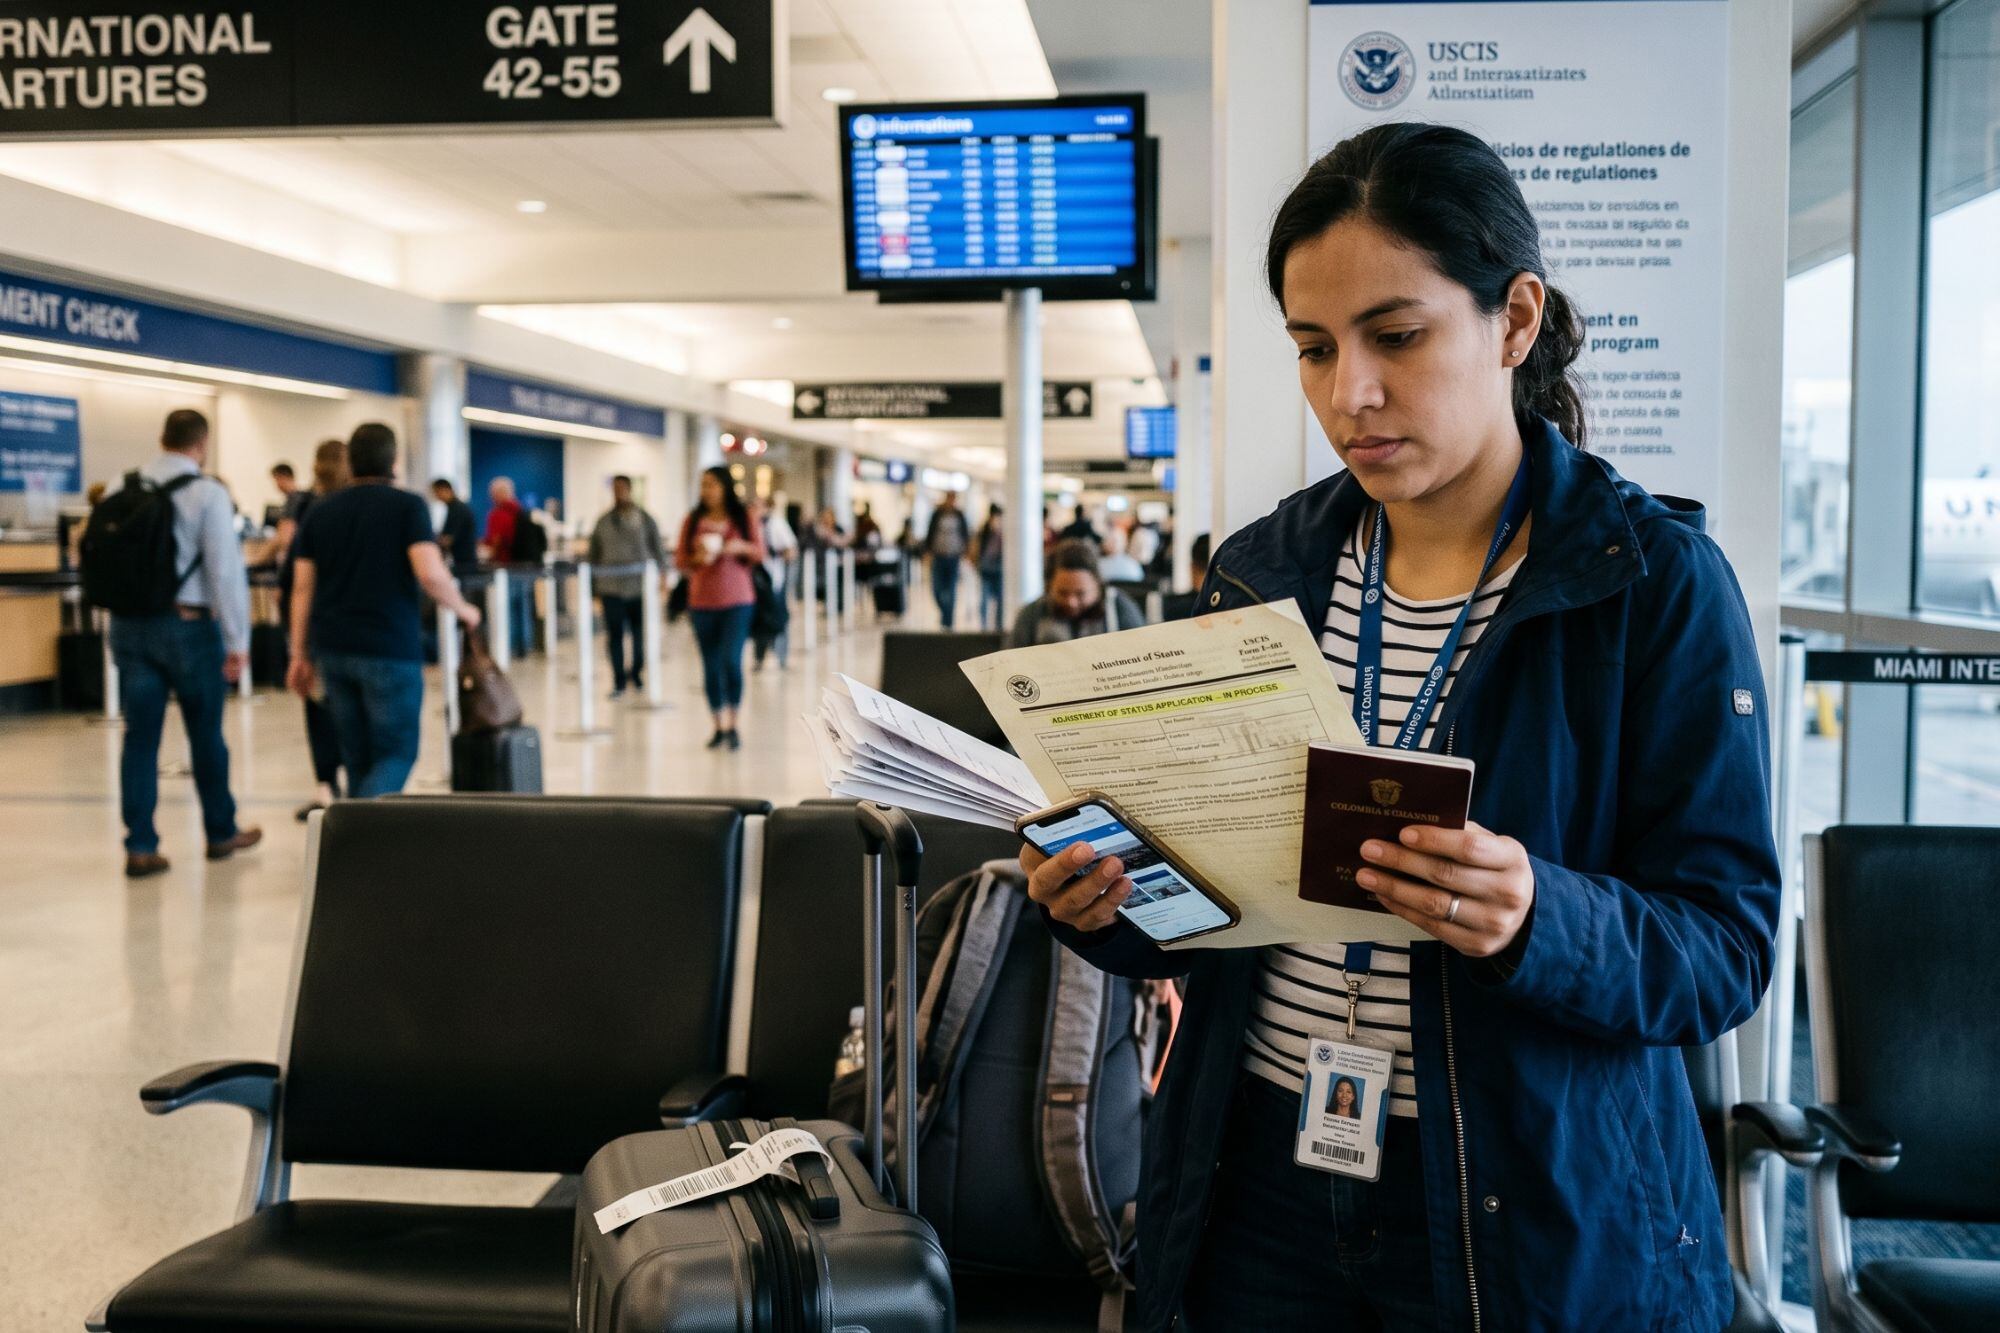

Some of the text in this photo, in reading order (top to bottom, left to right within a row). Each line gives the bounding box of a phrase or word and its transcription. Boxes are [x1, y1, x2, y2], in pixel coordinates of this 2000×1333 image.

[0, 14, 272, 59] RNATIONAL
[485, 4, 619, 48] GATE
[1427, 41, 1498, 62] USCIS
[482, 55, 622, 99] 42-55
[1428, 67, 1458, 82] and
[1539, 141, 1559, 158] de
[1563, 141, 1666, 162] regulationes
[1670, 141, 1692, 158] de
[1531, 164, 1551, 180] de
[1555, 164, 1658, 184] regulationes
[64, 296, 140, 344] CHECK
[1618, 314, 1638, 327] en
[1591, 336, 1660, 354] program
[1875, 657, 2000, 680] MIAMI INTE
[1107, 706, 1118, 716] OF
[1120, 701, 1154, 716] STATUS
[1155, 693, 1213, 711] APPLICATION
[1234, 683, 1279, 696] PROCESS
